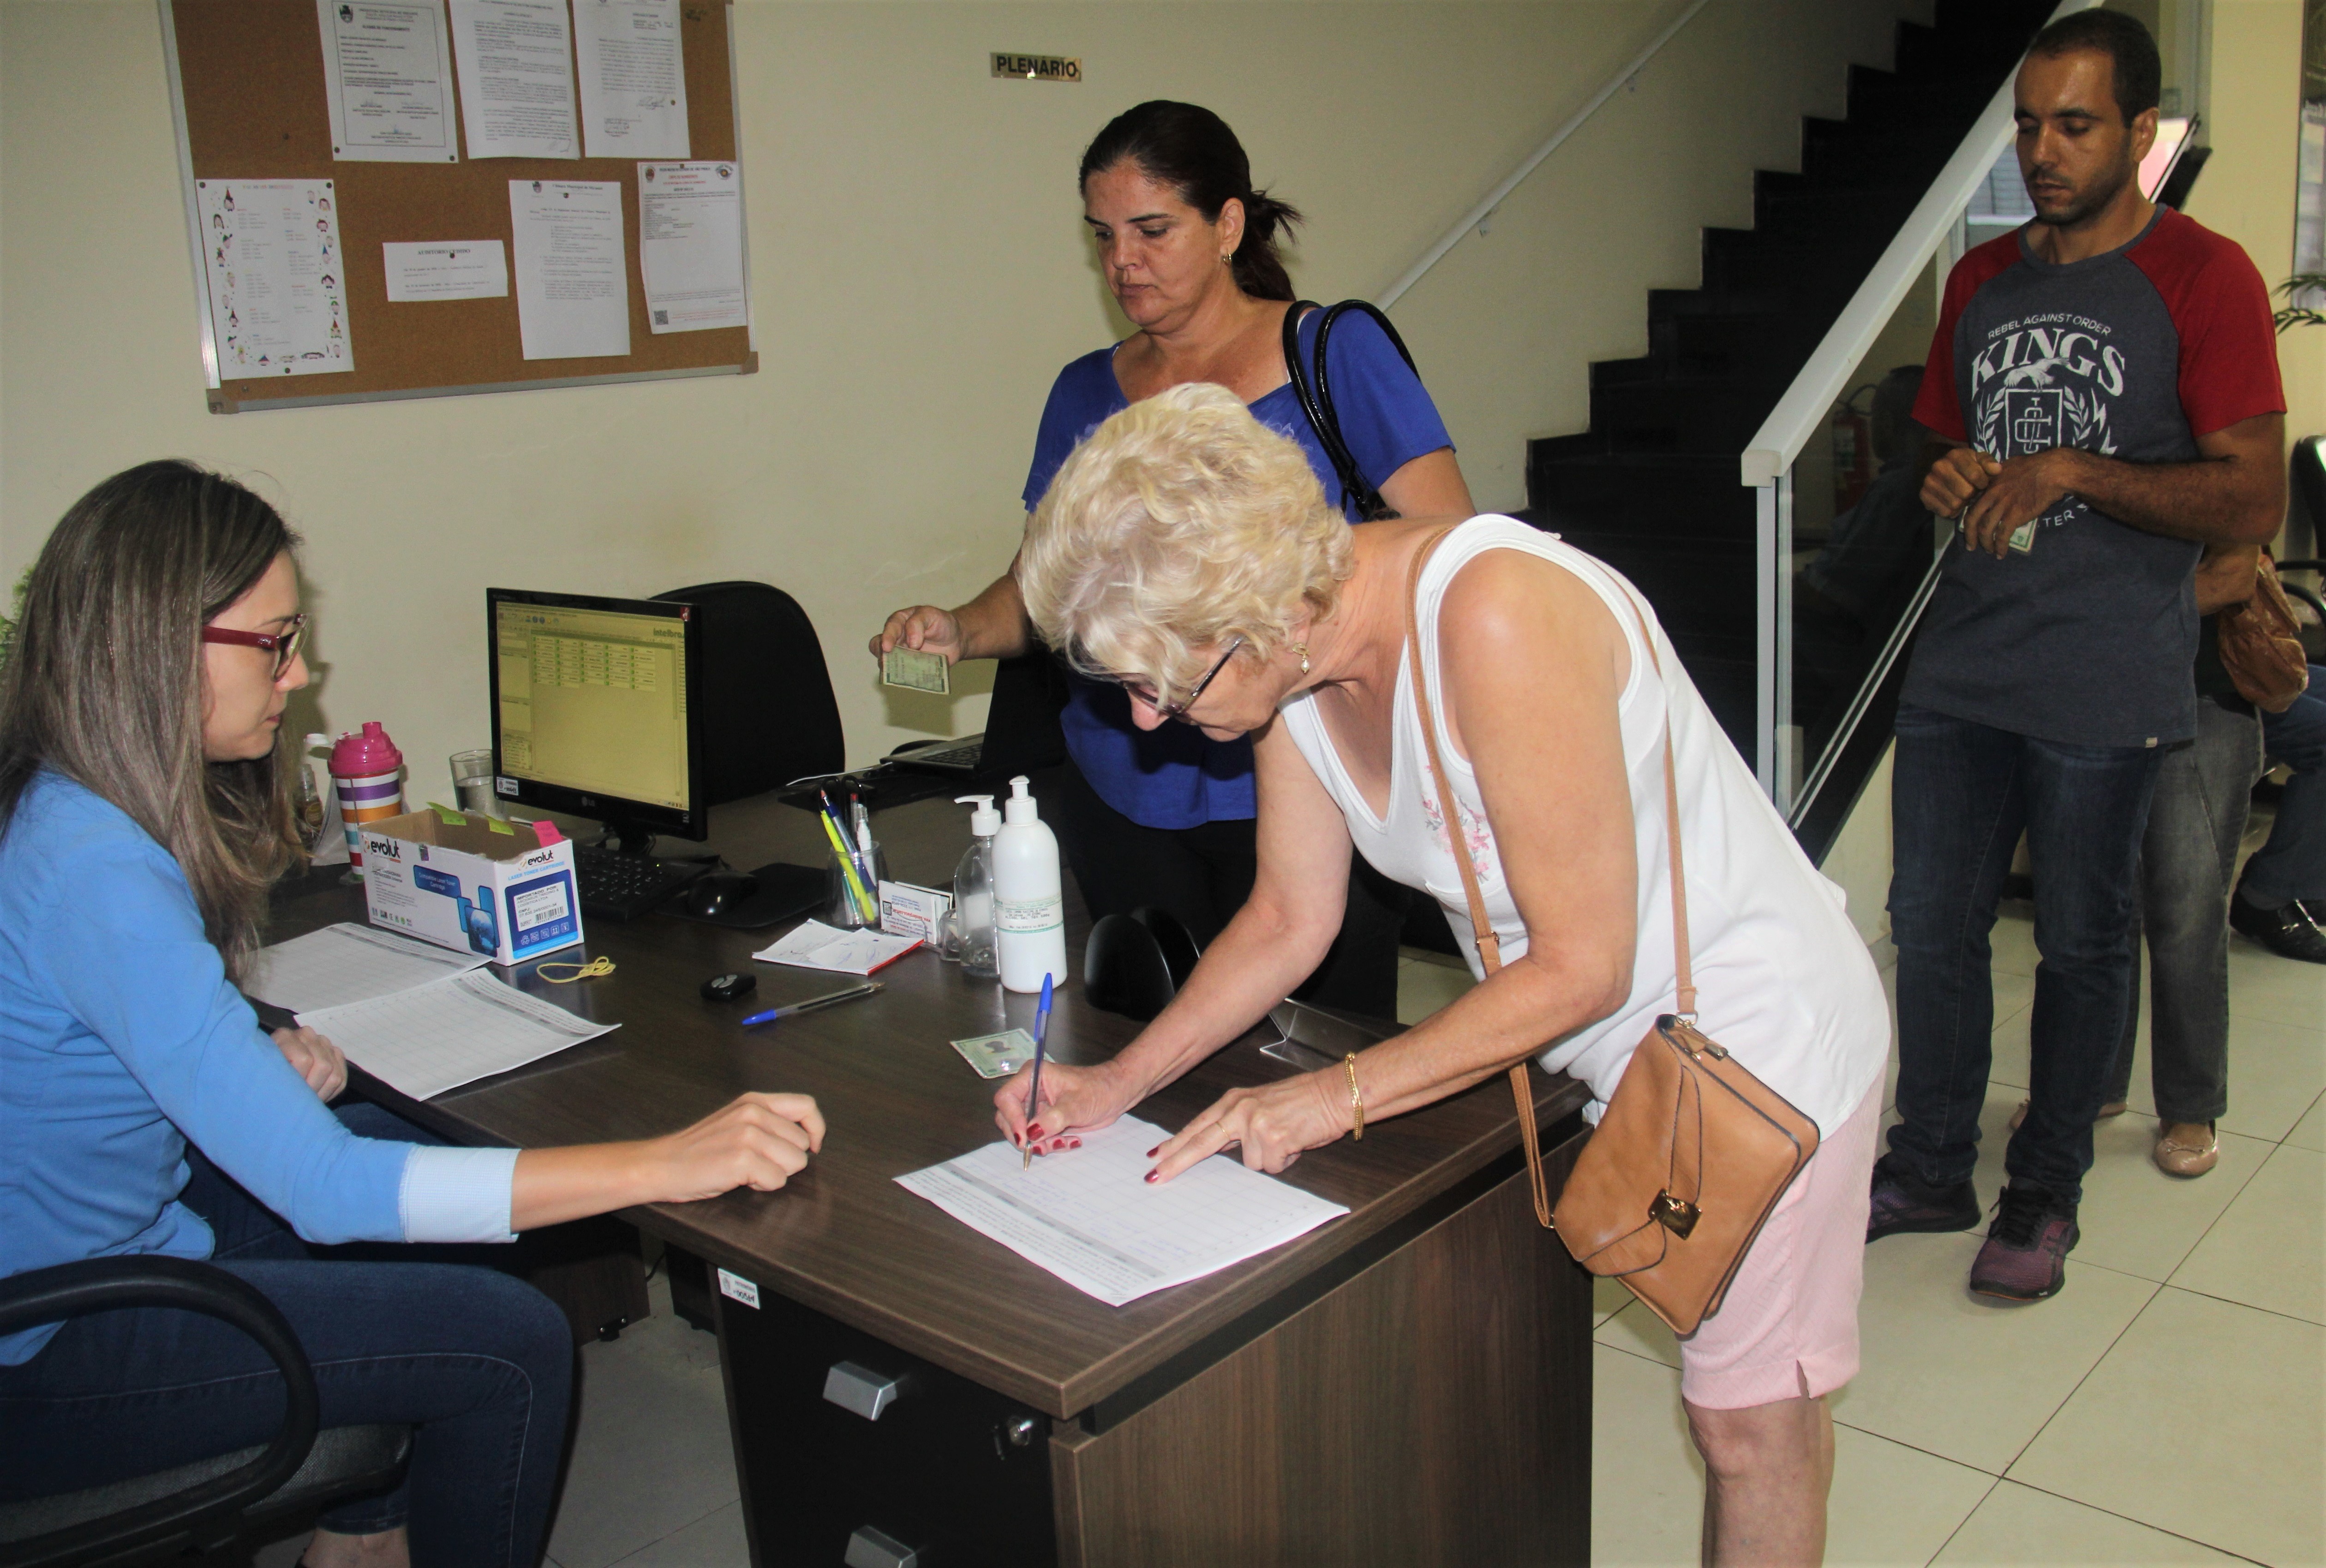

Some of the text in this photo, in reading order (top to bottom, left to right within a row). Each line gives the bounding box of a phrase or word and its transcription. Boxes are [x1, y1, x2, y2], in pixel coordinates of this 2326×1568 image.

[1988, 313, 2112, 340] REBEL AGAINST ORDER
[1971, 328, 2125, 402] KINGS
[2042, 509, 2075, 527] TER
[371, 838, 400, 859] evolut
[528, 850, 554, 865] evolut
[539, 861, 565, 871] CARTRIDGE
